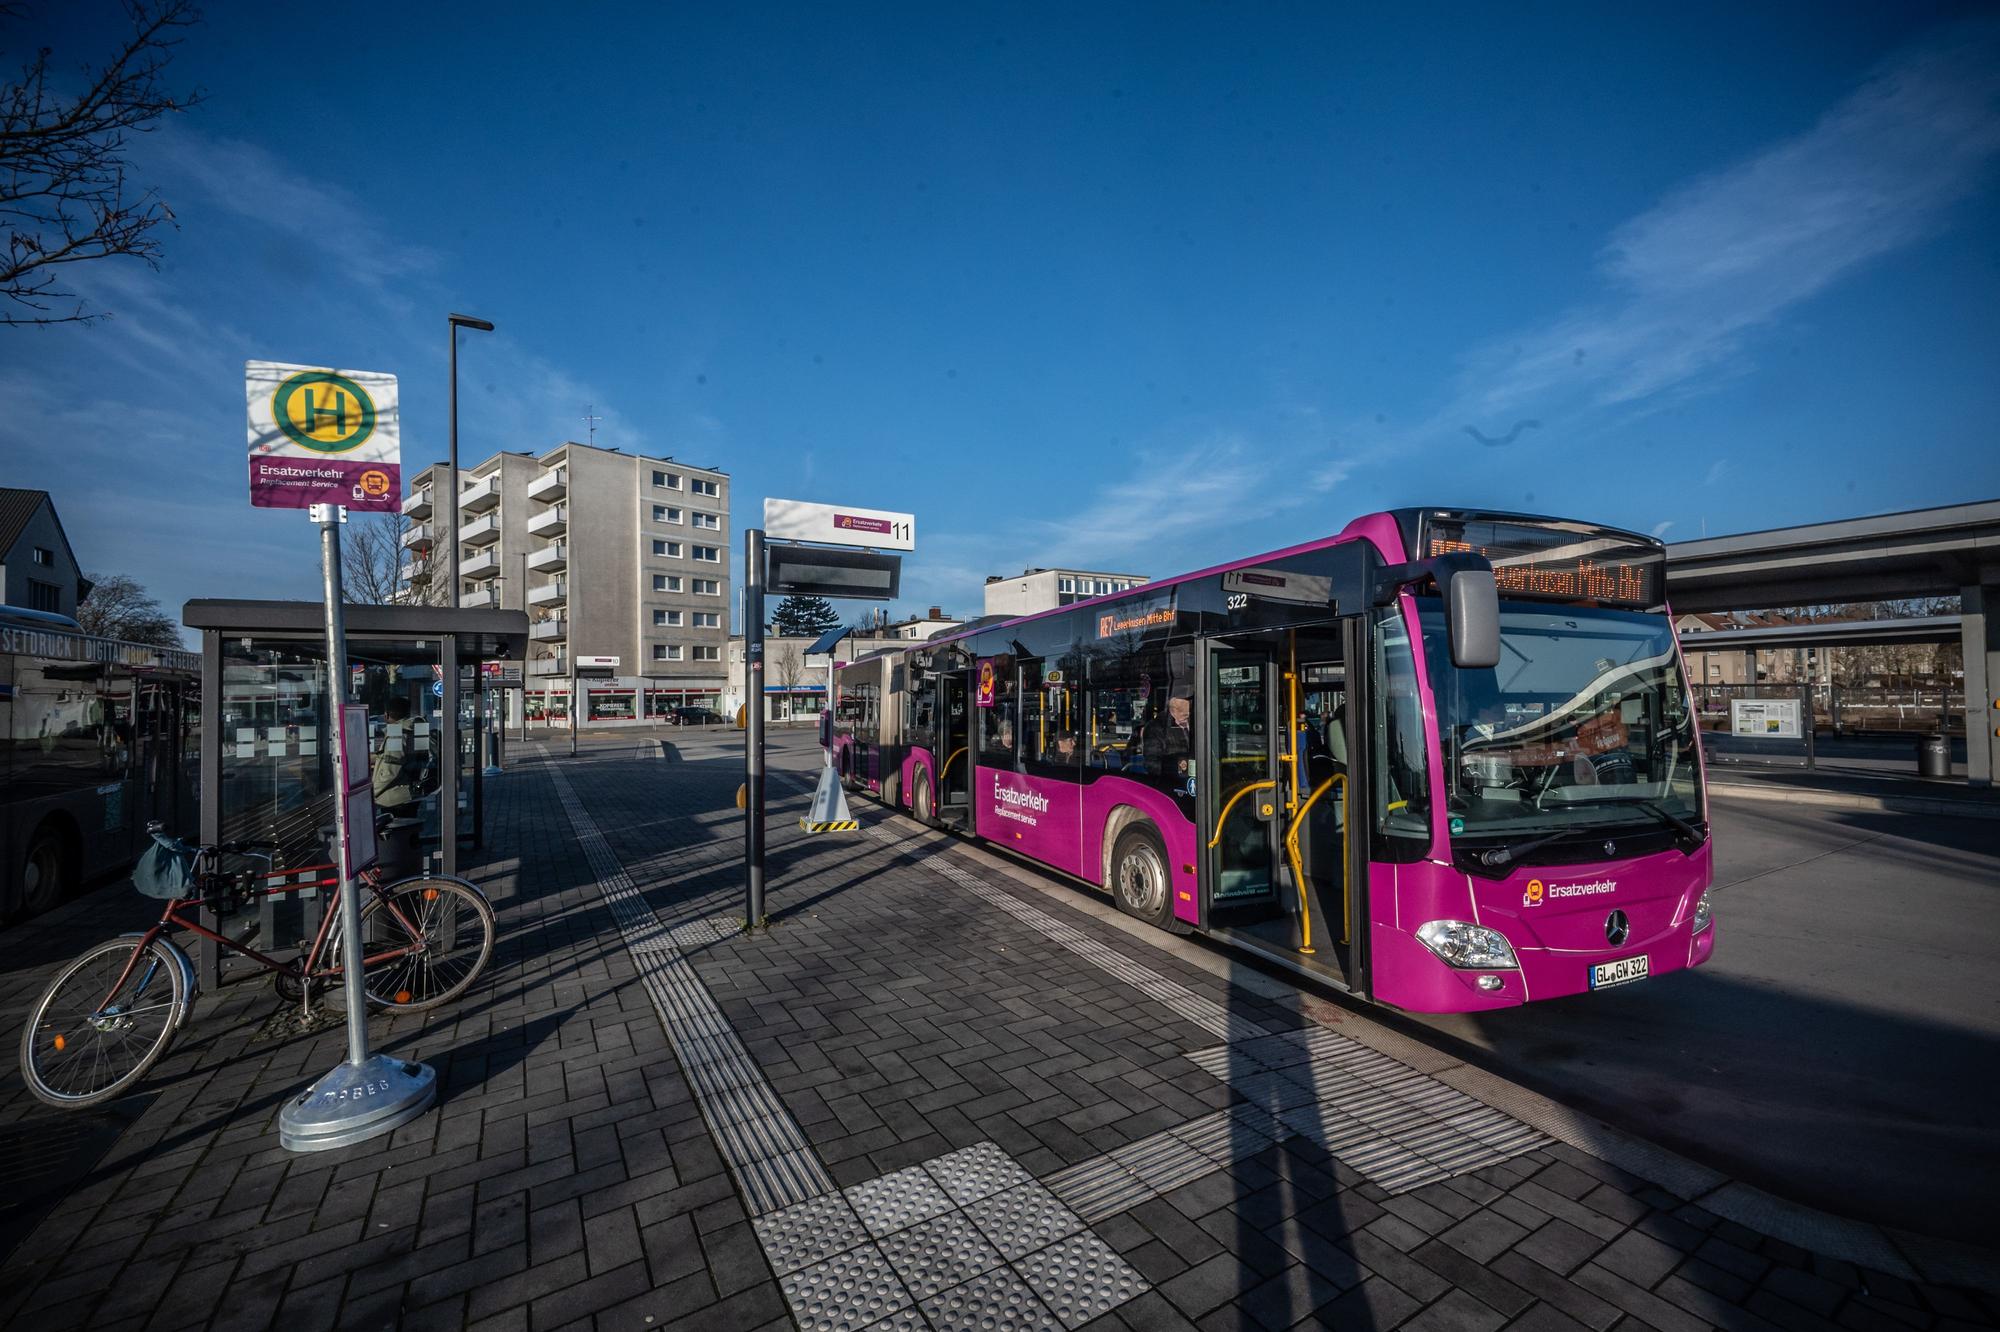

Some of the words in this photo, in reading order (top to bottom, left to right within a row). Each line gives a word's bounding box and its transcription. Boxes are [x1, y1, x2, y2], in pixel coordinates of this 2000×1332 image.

[304, 388, 346, 435] H
[259, 464, 344, 479] Ersatzverkehr
[260, 477, 310, 487] Replacement
[311, 480, 339, 488] Service
[852, 519, 883, 527] Ersatzverkehr
[892, 522, 910, 541] 11
[1579, 559, 1615, 597] Mitte
[1619, 564, 1644, 600] Bhf
[1227, 593, 1247, 610] 322
[1100, 615, 1113, 638] RE7
[1147, 611, 1162, 625] Mitte
[1163, 609, 1175, 622] Bhf
[2, 627, 72, 657] SETDRUCK
[995, 782, 1049, 813] Ersatzverkehr
[994, 804, 1021, 822] Replacement
[1020, 814, 1037, 827] service
[1549, 879, 1616, 898] Ersatzverkehr
[1596, 966, 1610, 983] GL
[1616, 961, 1629, 979] GW
[1630, 957, 1647, 976] 322
